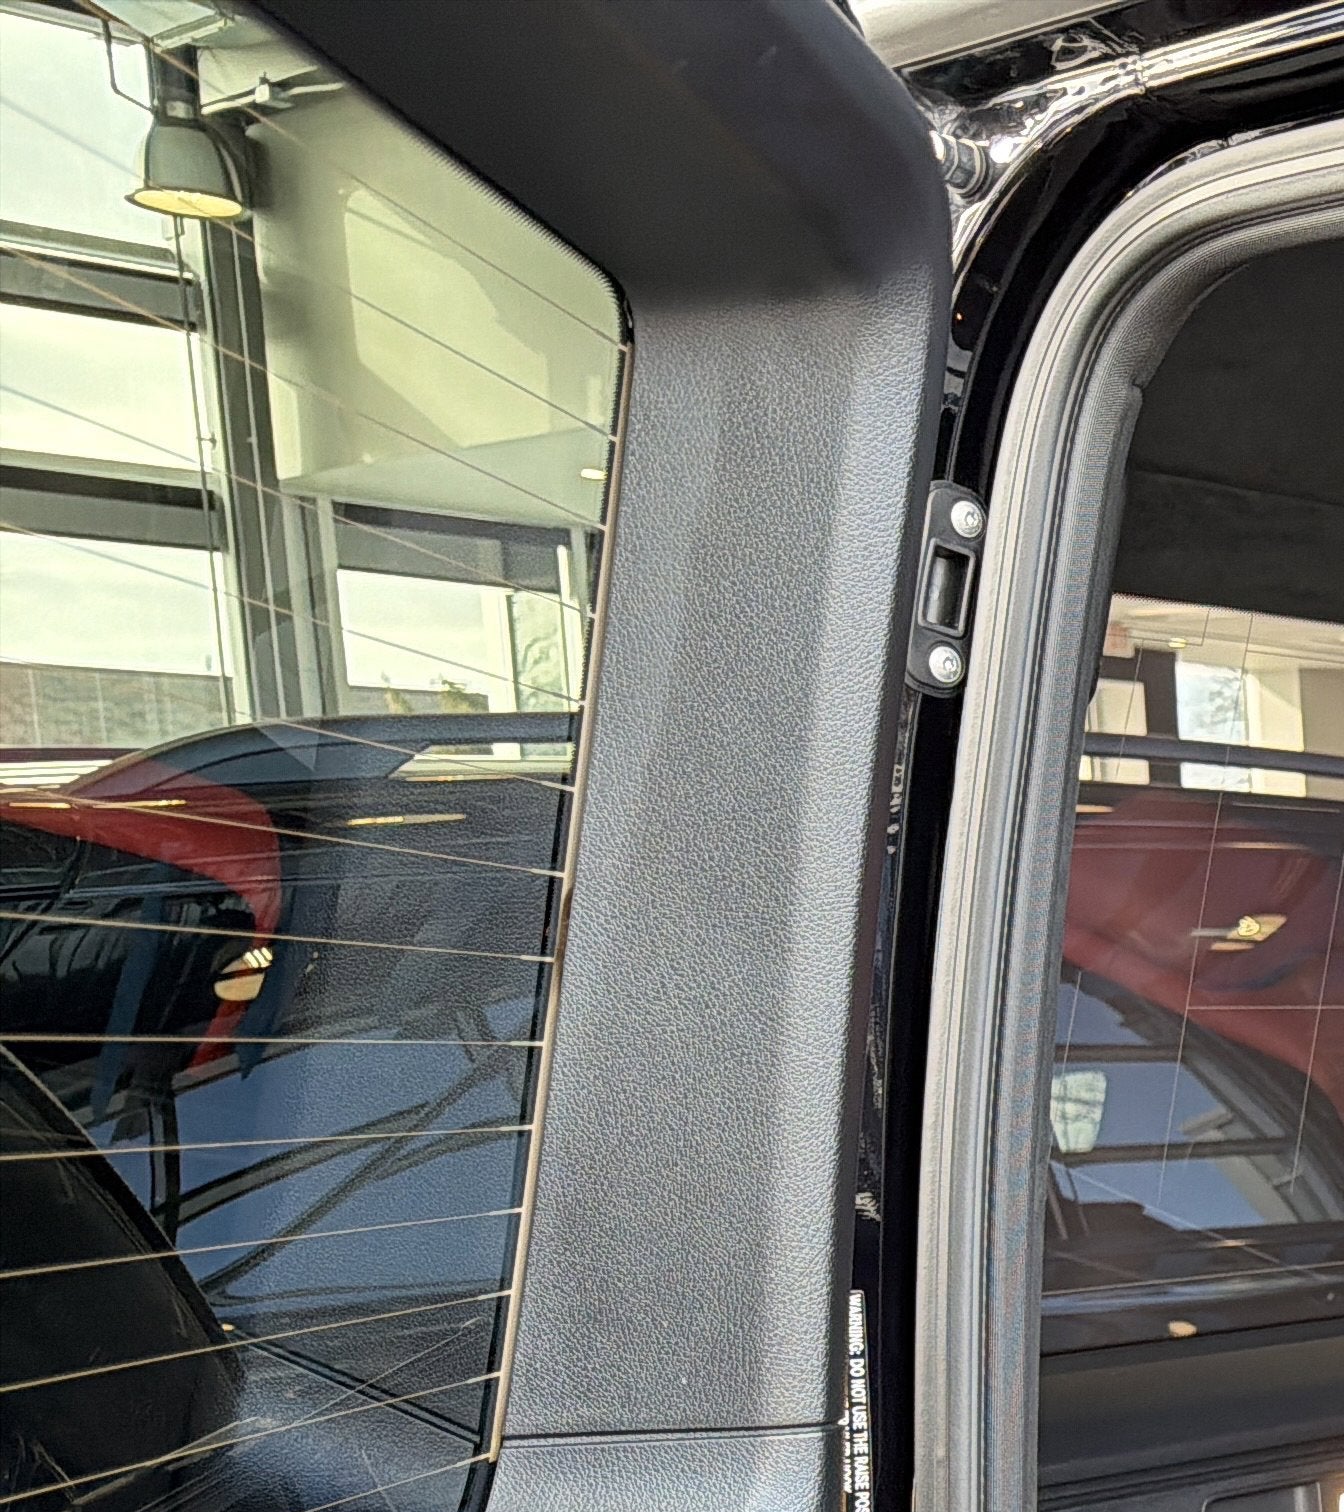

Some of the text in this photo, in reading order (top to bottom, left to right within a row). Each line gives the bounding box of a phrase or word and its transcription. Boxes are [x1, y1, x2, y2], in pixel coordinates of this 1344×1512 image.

[849, 1293, 865, 1355] WARNING:
[850, 1358, 865, 1377] DO
[851, 1379, 867, 1404] NOT
[852, 1405, 868, 1430] USE
[853, 1430, 869, 1455] THE
[854, 1456, 870, 1490] RAISE
